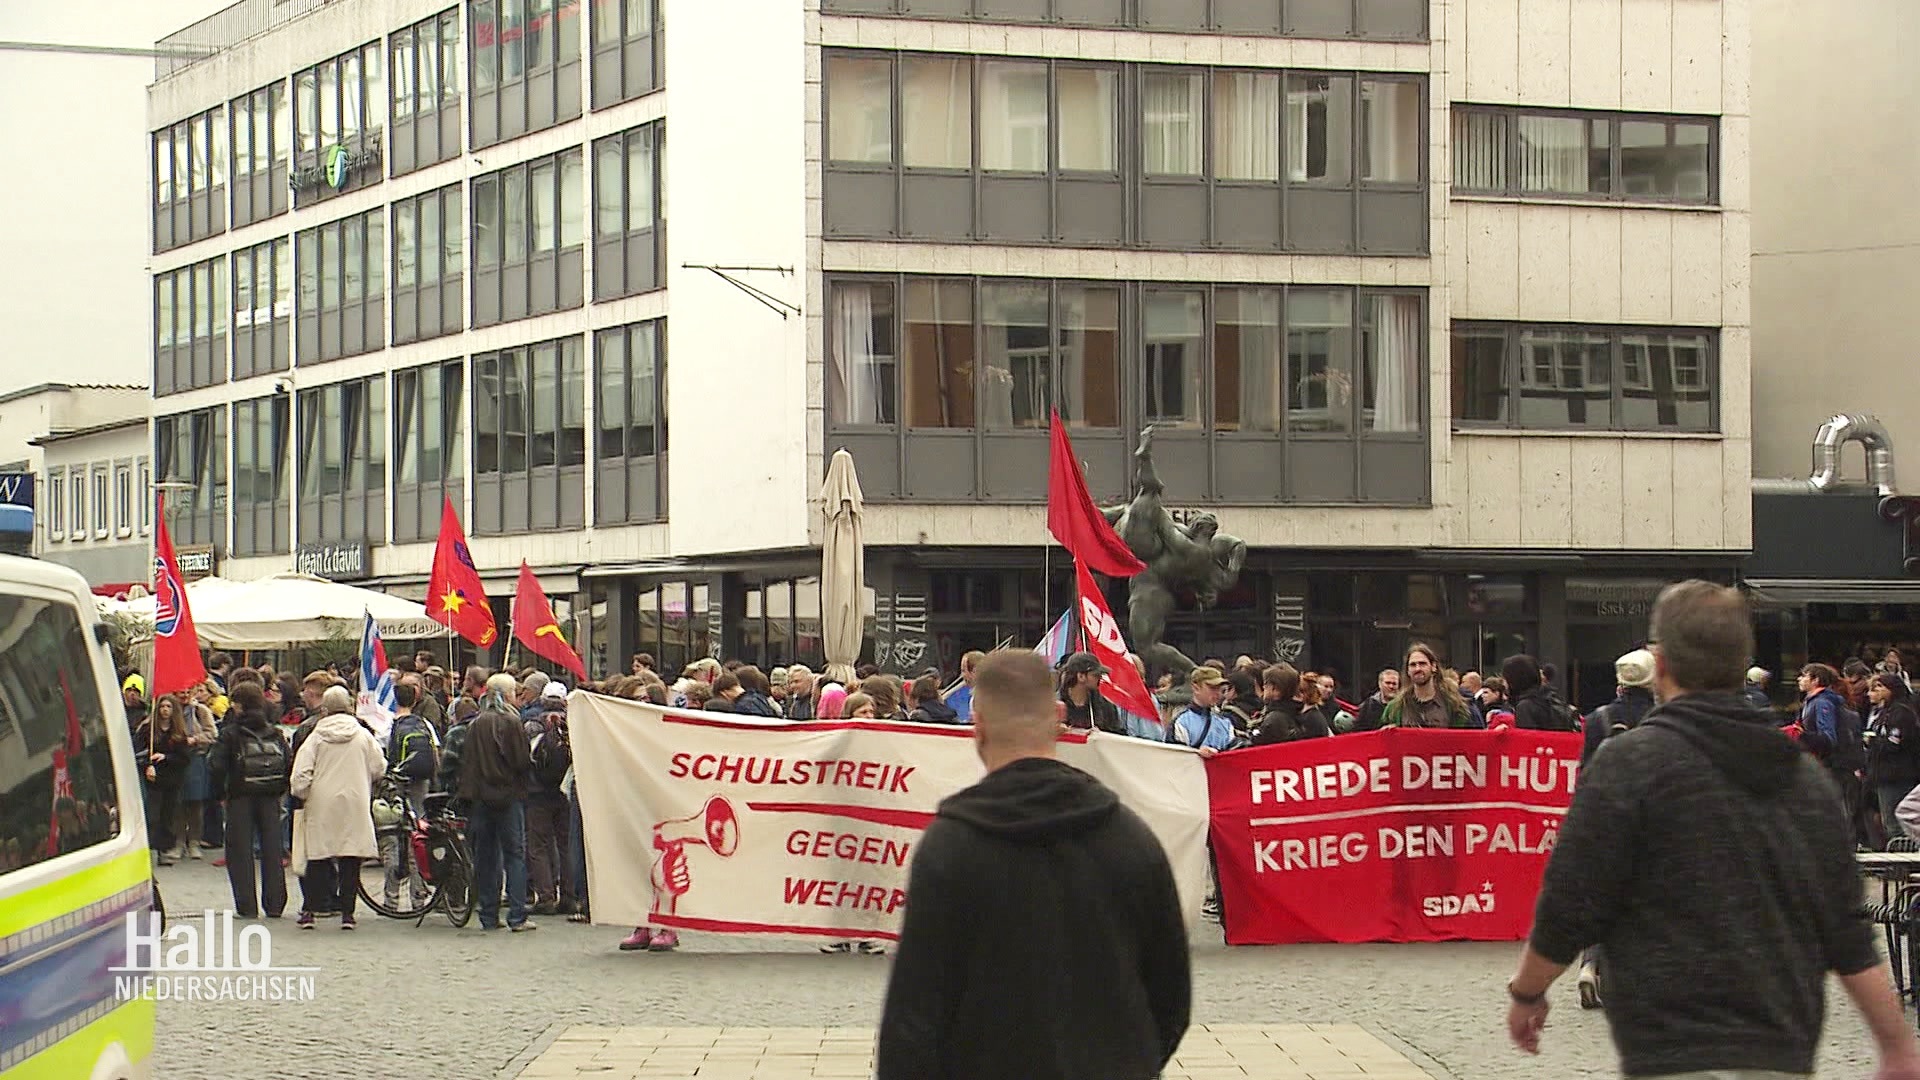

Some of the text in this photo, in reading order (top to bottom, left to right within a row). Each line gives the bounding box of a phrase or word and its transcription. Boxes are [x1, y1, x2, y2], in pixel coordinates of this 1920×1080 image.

[298, 543, 361, 576] dean & david
[895, 592, 926, 633] ZEIT
[1275, 593, 1304, 631] ZEIT
[669, 752, 916, 793] SCHULSTREIK
[1250, 757, 1391, 804] FRIEDE
[1401, 754, 1487, 791] DEN
[785, 829, 910, 867] GEGEN
[1253, 831, 1369, 873] KRIEG
[1377, 824, 1455, 860] DEN
[1422, 892, 1496, 918] SDAJ
